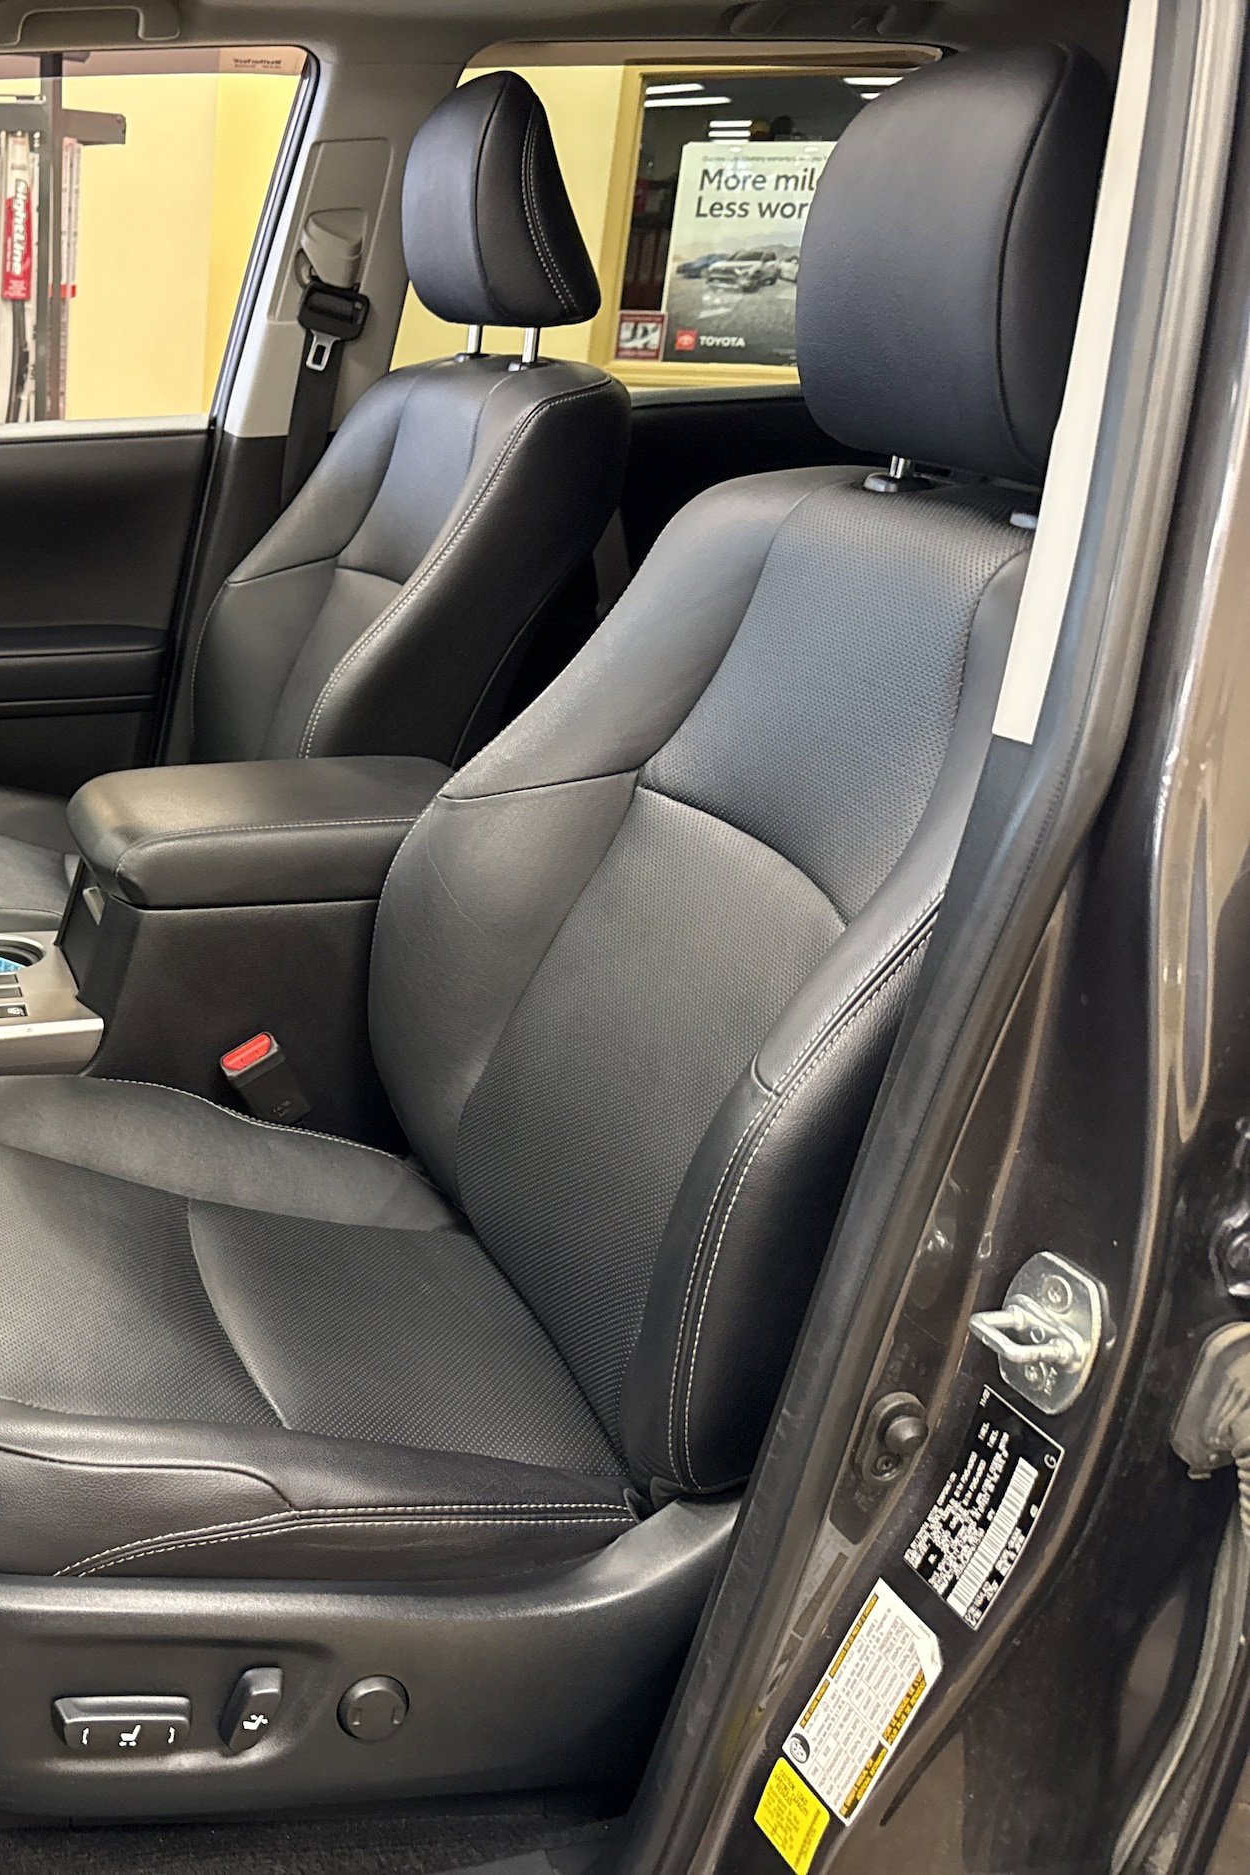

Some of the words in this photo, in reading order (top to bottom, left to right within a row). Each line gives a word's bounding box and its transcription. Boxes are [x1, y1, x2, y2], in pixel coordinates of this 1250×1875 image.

[699, 168, 767, 191] More
[774, 167, 816, 191] mil
[695, 195, 750, 218] Less
[758, 201, 809, 219] wor
[699, 336, 746, 348] TOYOTA
[1044, 1453, 1057, 1469] G
